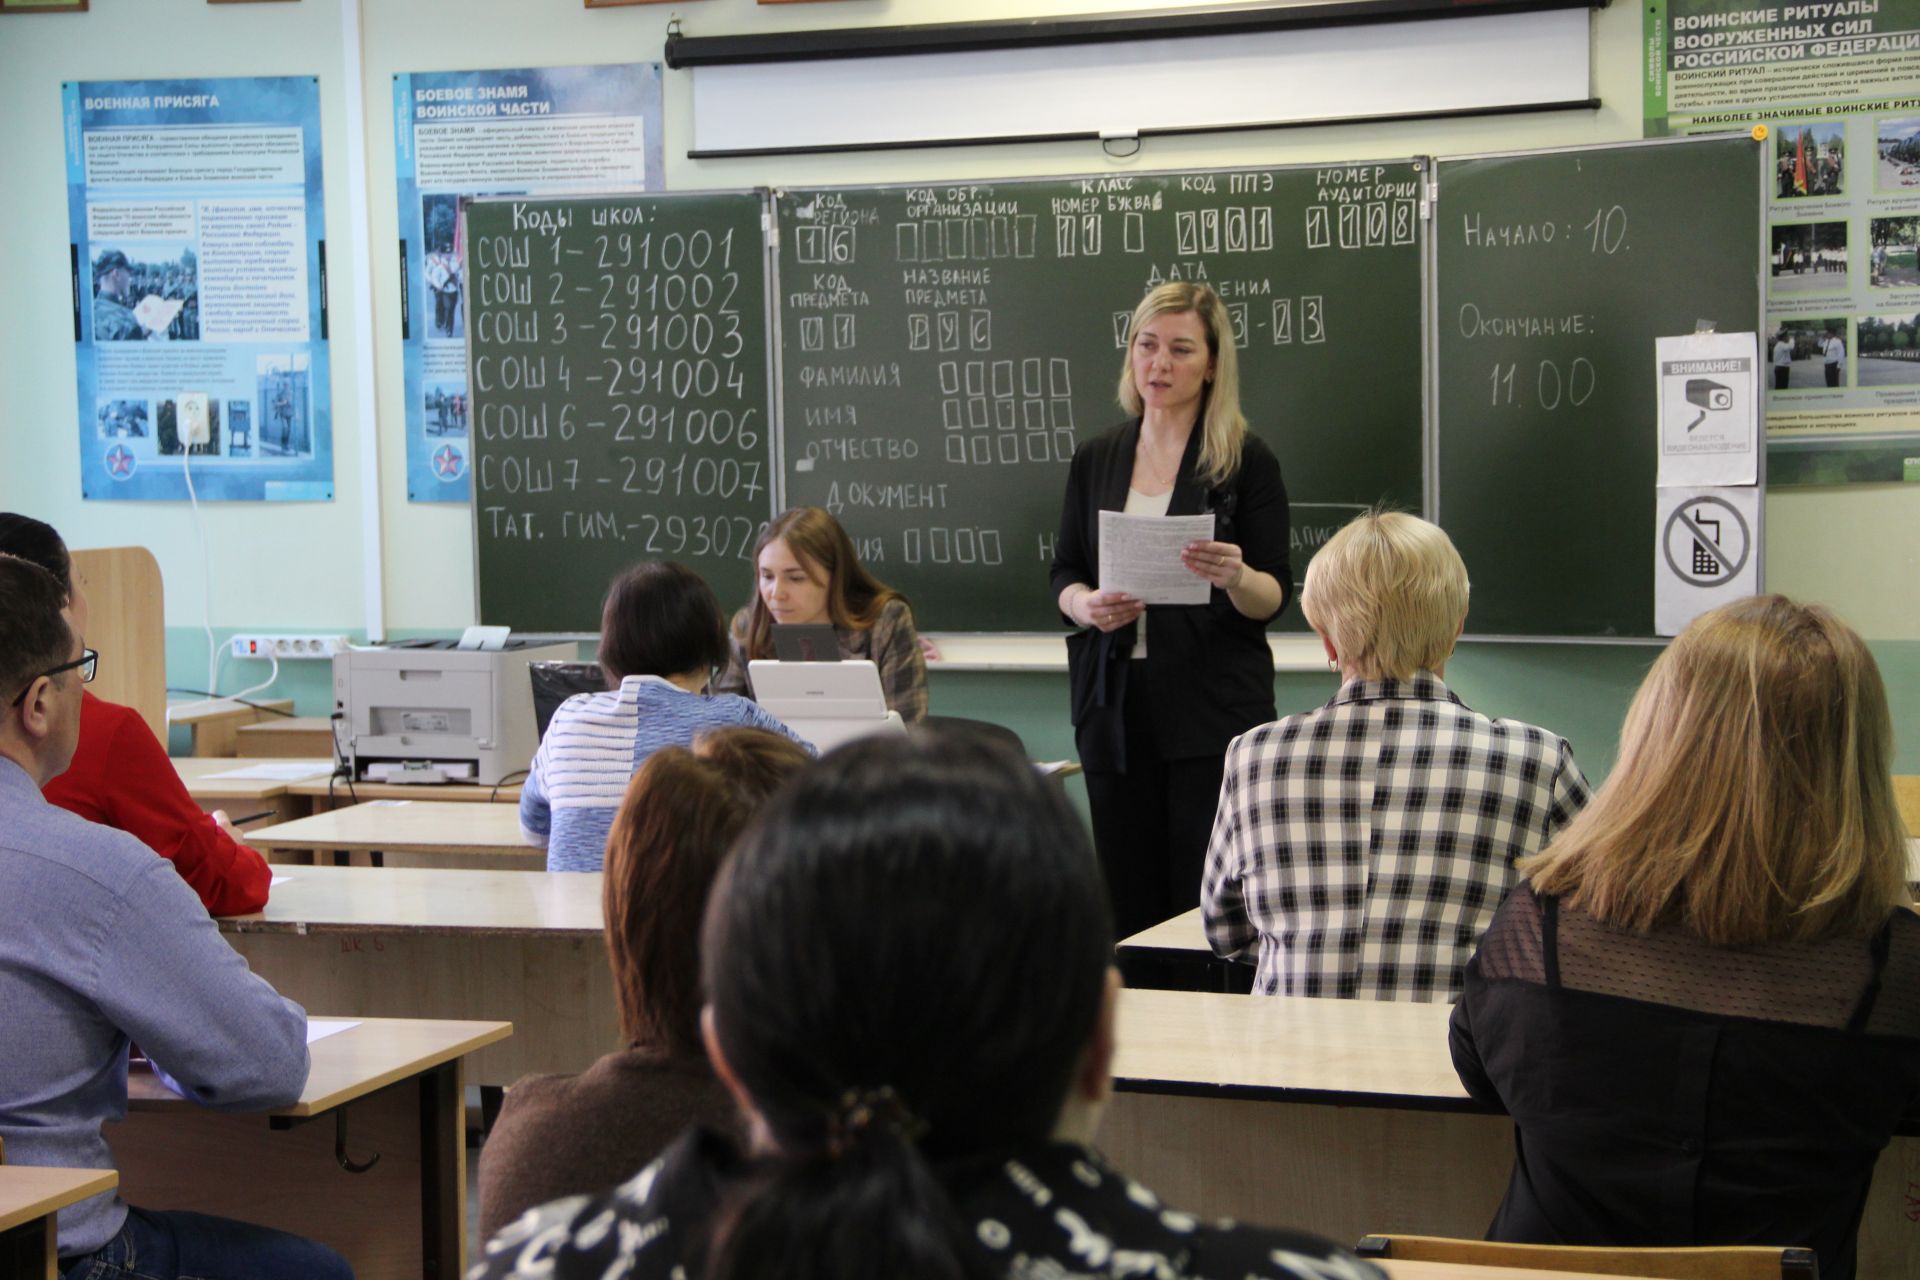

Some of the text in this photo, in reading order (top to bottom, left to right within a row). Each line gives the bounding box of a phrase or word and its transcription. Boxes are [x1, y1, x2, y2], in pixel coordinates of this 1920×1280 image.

[1674, 0, 1879, 31] ВОИНСКИЕ РИТУАЛЫ
[1674, 19, 1873, 50] ВООРУЖЕННЫХ СИЛ
[1674, 32, 1920, 68] РОССИЙСКОЙ ФЕДЕРАЦИ
[1674, 69, 1726, 81] ВОИНСКИЙ
[1729, 66, 1765, 77] РИТУАЛ
[84, 95, 220, 111] ВОЕННАЯ ПРИСЯГА
[416, 85, 528, 102] БОЕВОЕ ЗНАМЯ
[416, 101, 550, 118] ВОИНСКОЙ ЧАСТИ
[1692, 112, 1753, 124] НАИБОЛЕЕ
[1757, 107, 1822, 120] ЗНАЧИМЫЕ
[1826, 102, 1889, 114] ВОИНСКИЕ
[1081, 177, 1134, 195] КЛАСС
[1181, 173, 1274, 195] КОД ППЭ
[1317, 166, 1386, 186] НОМЕР
[815, 193, 847, 210] КОД
[906, 186, 983, 205] КОД ОБР.
[1317, 181, 1417, 203] АУДИТОРИИ
[906, 200, 1018, 218] ОРГАНИЗАЦИИ
[1051, 194, 1151, 216] НОМЕР БУКВА
[478, 235, 530, 269] СОШ
[595, 228, 734, 271] 291001
[813, 273, 852, 293] КОД
[902, 267, 991, 286] НАЗВАНИЕ
[1146, 260, 1209, 286] ДАТА
[480, 271, 532, 307] СОШ
[549, 271, 565, 305] 2
[599, 271, 741, 316] 291002
[790, 291, 870, 309] ПРЕДМЕТА
[904, 288, 988, 309] ПРЕДМЕТА
[478, 310, 539, 344] СОШ
[550, 312, 568, 345] 3
[600, 312, 744, 359] 291003
[475, 354, 546, 392] СОШ
[558, 355, 571, 393] 4
[603, 355, 745, 400] 291004
[799, 362, 902, 389] ФАМИЛИЯ
[1670, 360, 1742, 376] ВНИМАНИЕ!
[480, 401, 548, 441] СОШ
[559, 403, 577, 442] 6
[611, 403, 758, 451] 291006
[804, 403, 858, 428] ИМЯ
[805, 436, 919, 462] ОТЧЕСТВО
[481, 453, 553, 493] СОШ
[562, 459, 581, 491] 7
[618, 453, 764, 502] 291007
[825, 480, 949, 516] ДОКУМЕНТ
